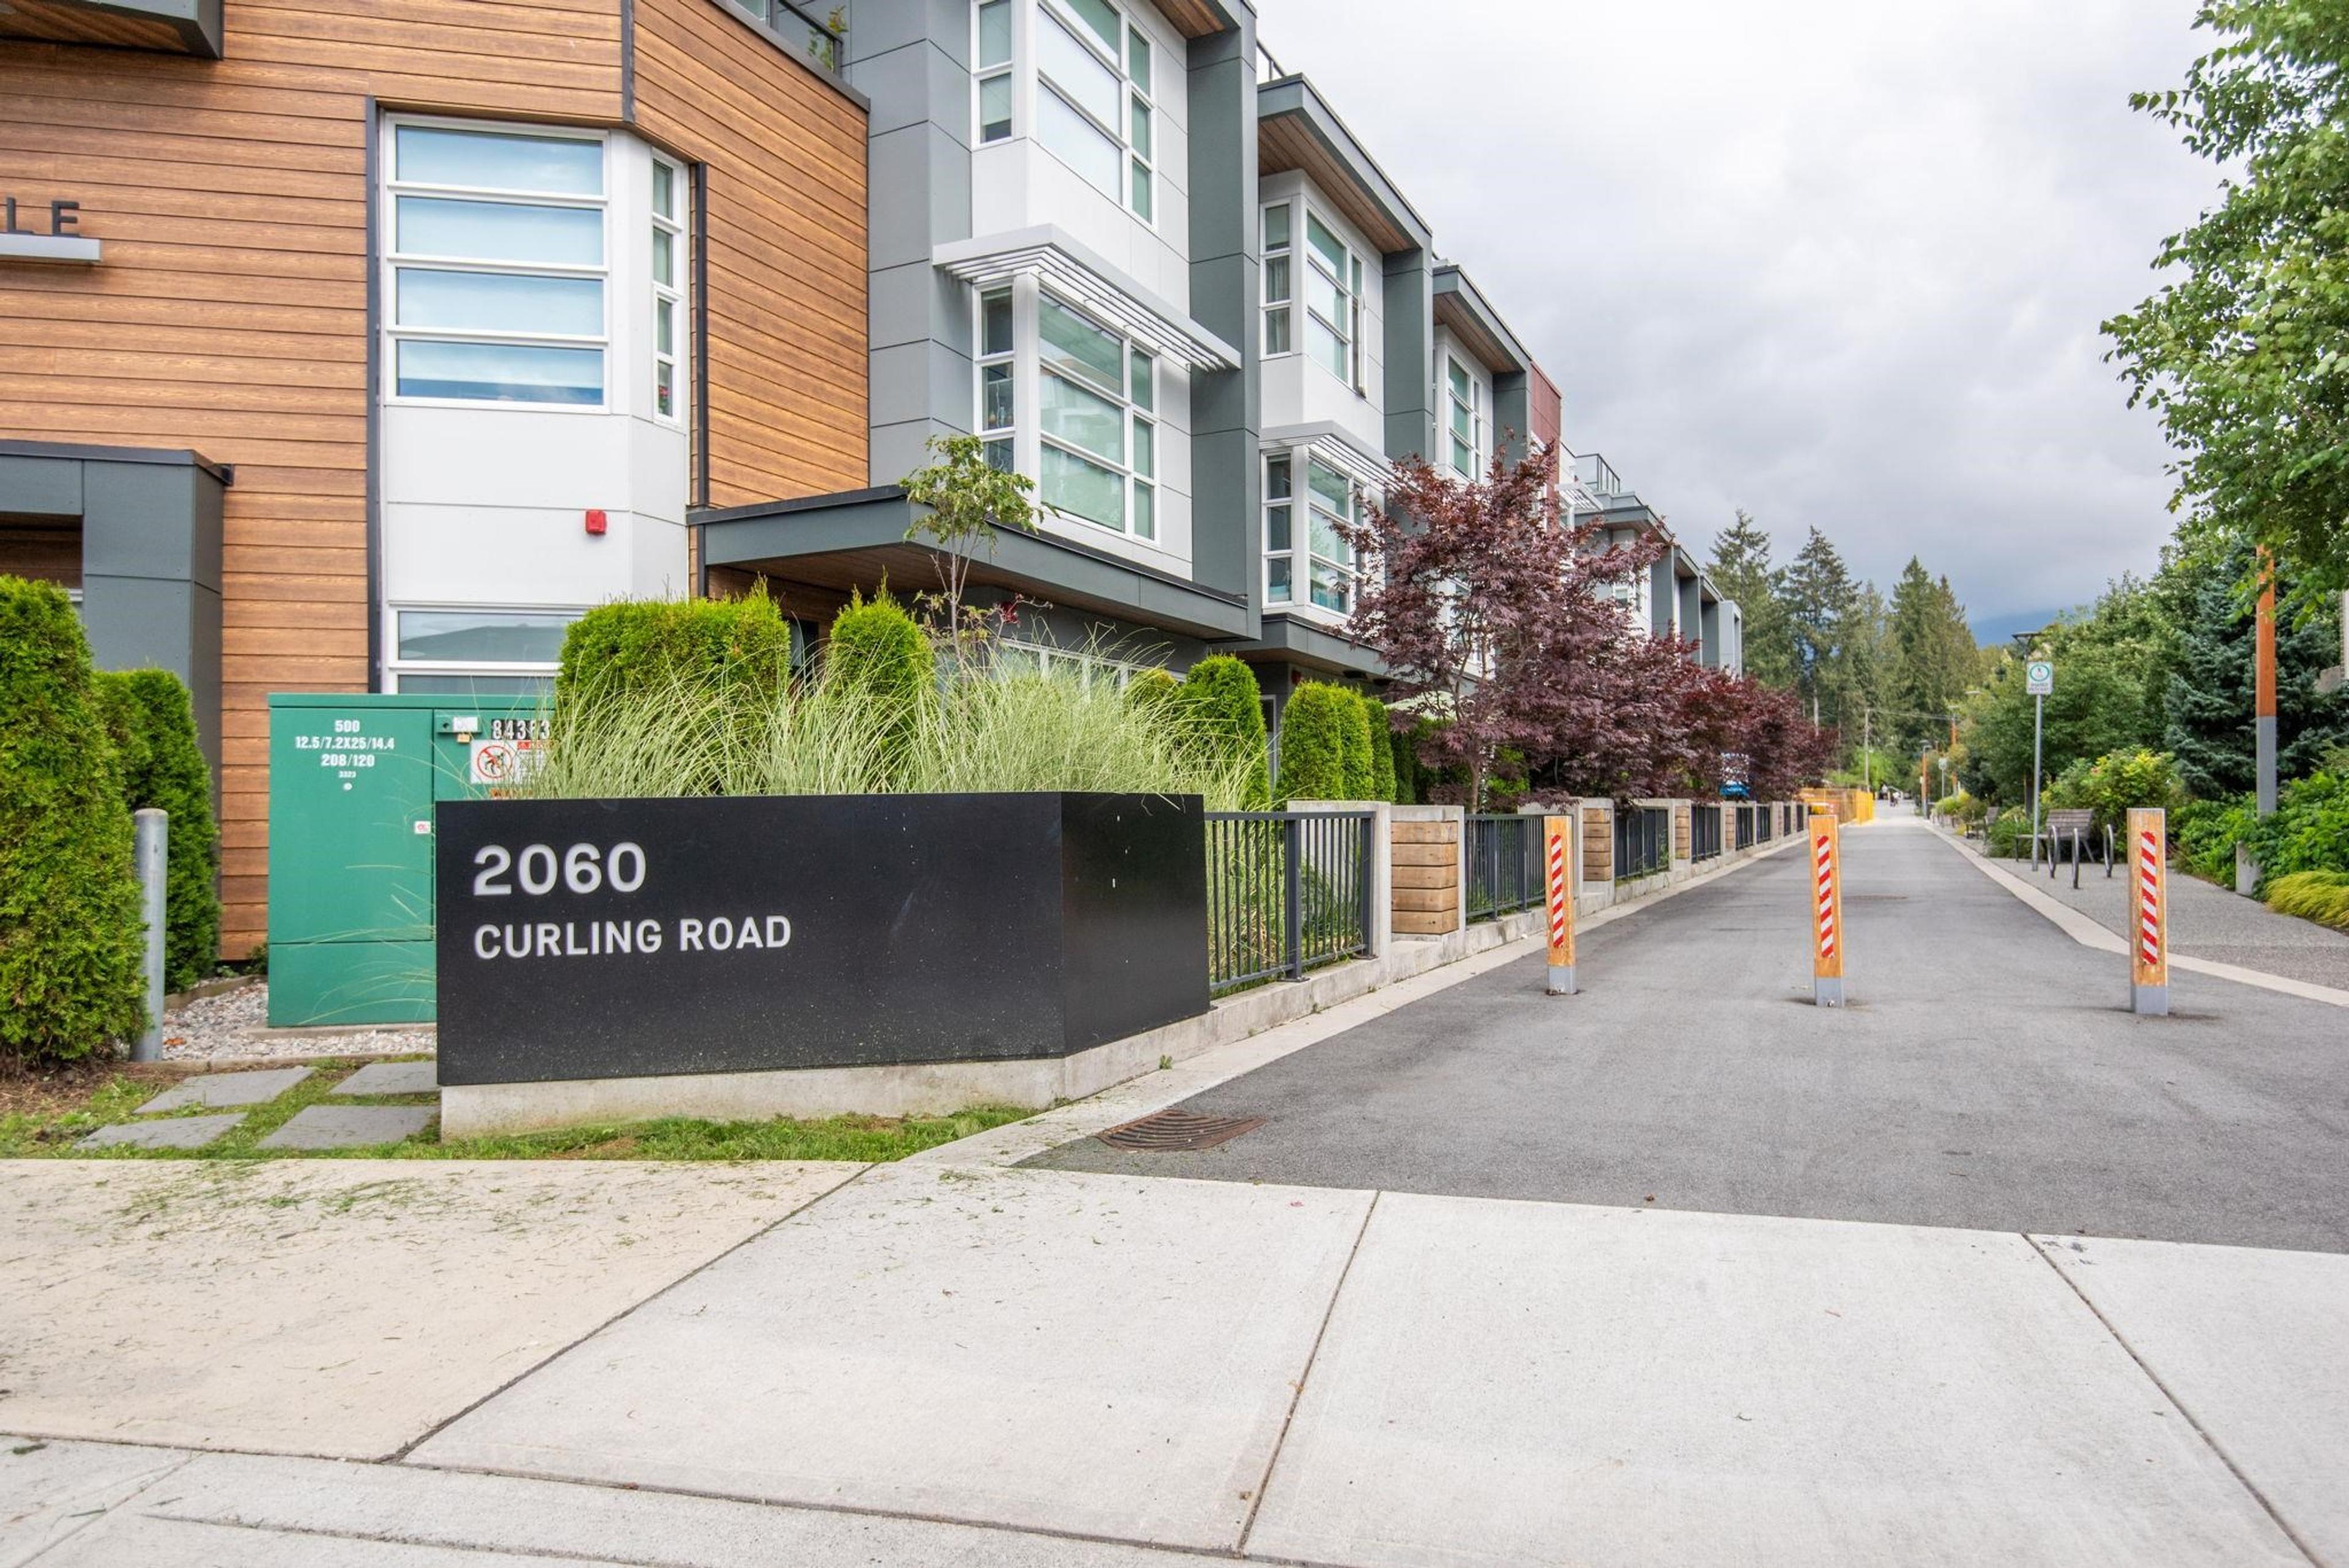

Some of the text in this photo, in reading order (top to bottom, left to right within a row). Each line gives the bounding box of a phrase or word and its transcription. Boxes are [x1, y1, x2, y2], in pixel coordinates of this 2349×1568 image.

[334, 719, 361, 733] 500
[321, 753, 376, 768] 208/120
[473, 842, 646, 896] 2060
[474, 915, 792, 959] CURLING ROAD
